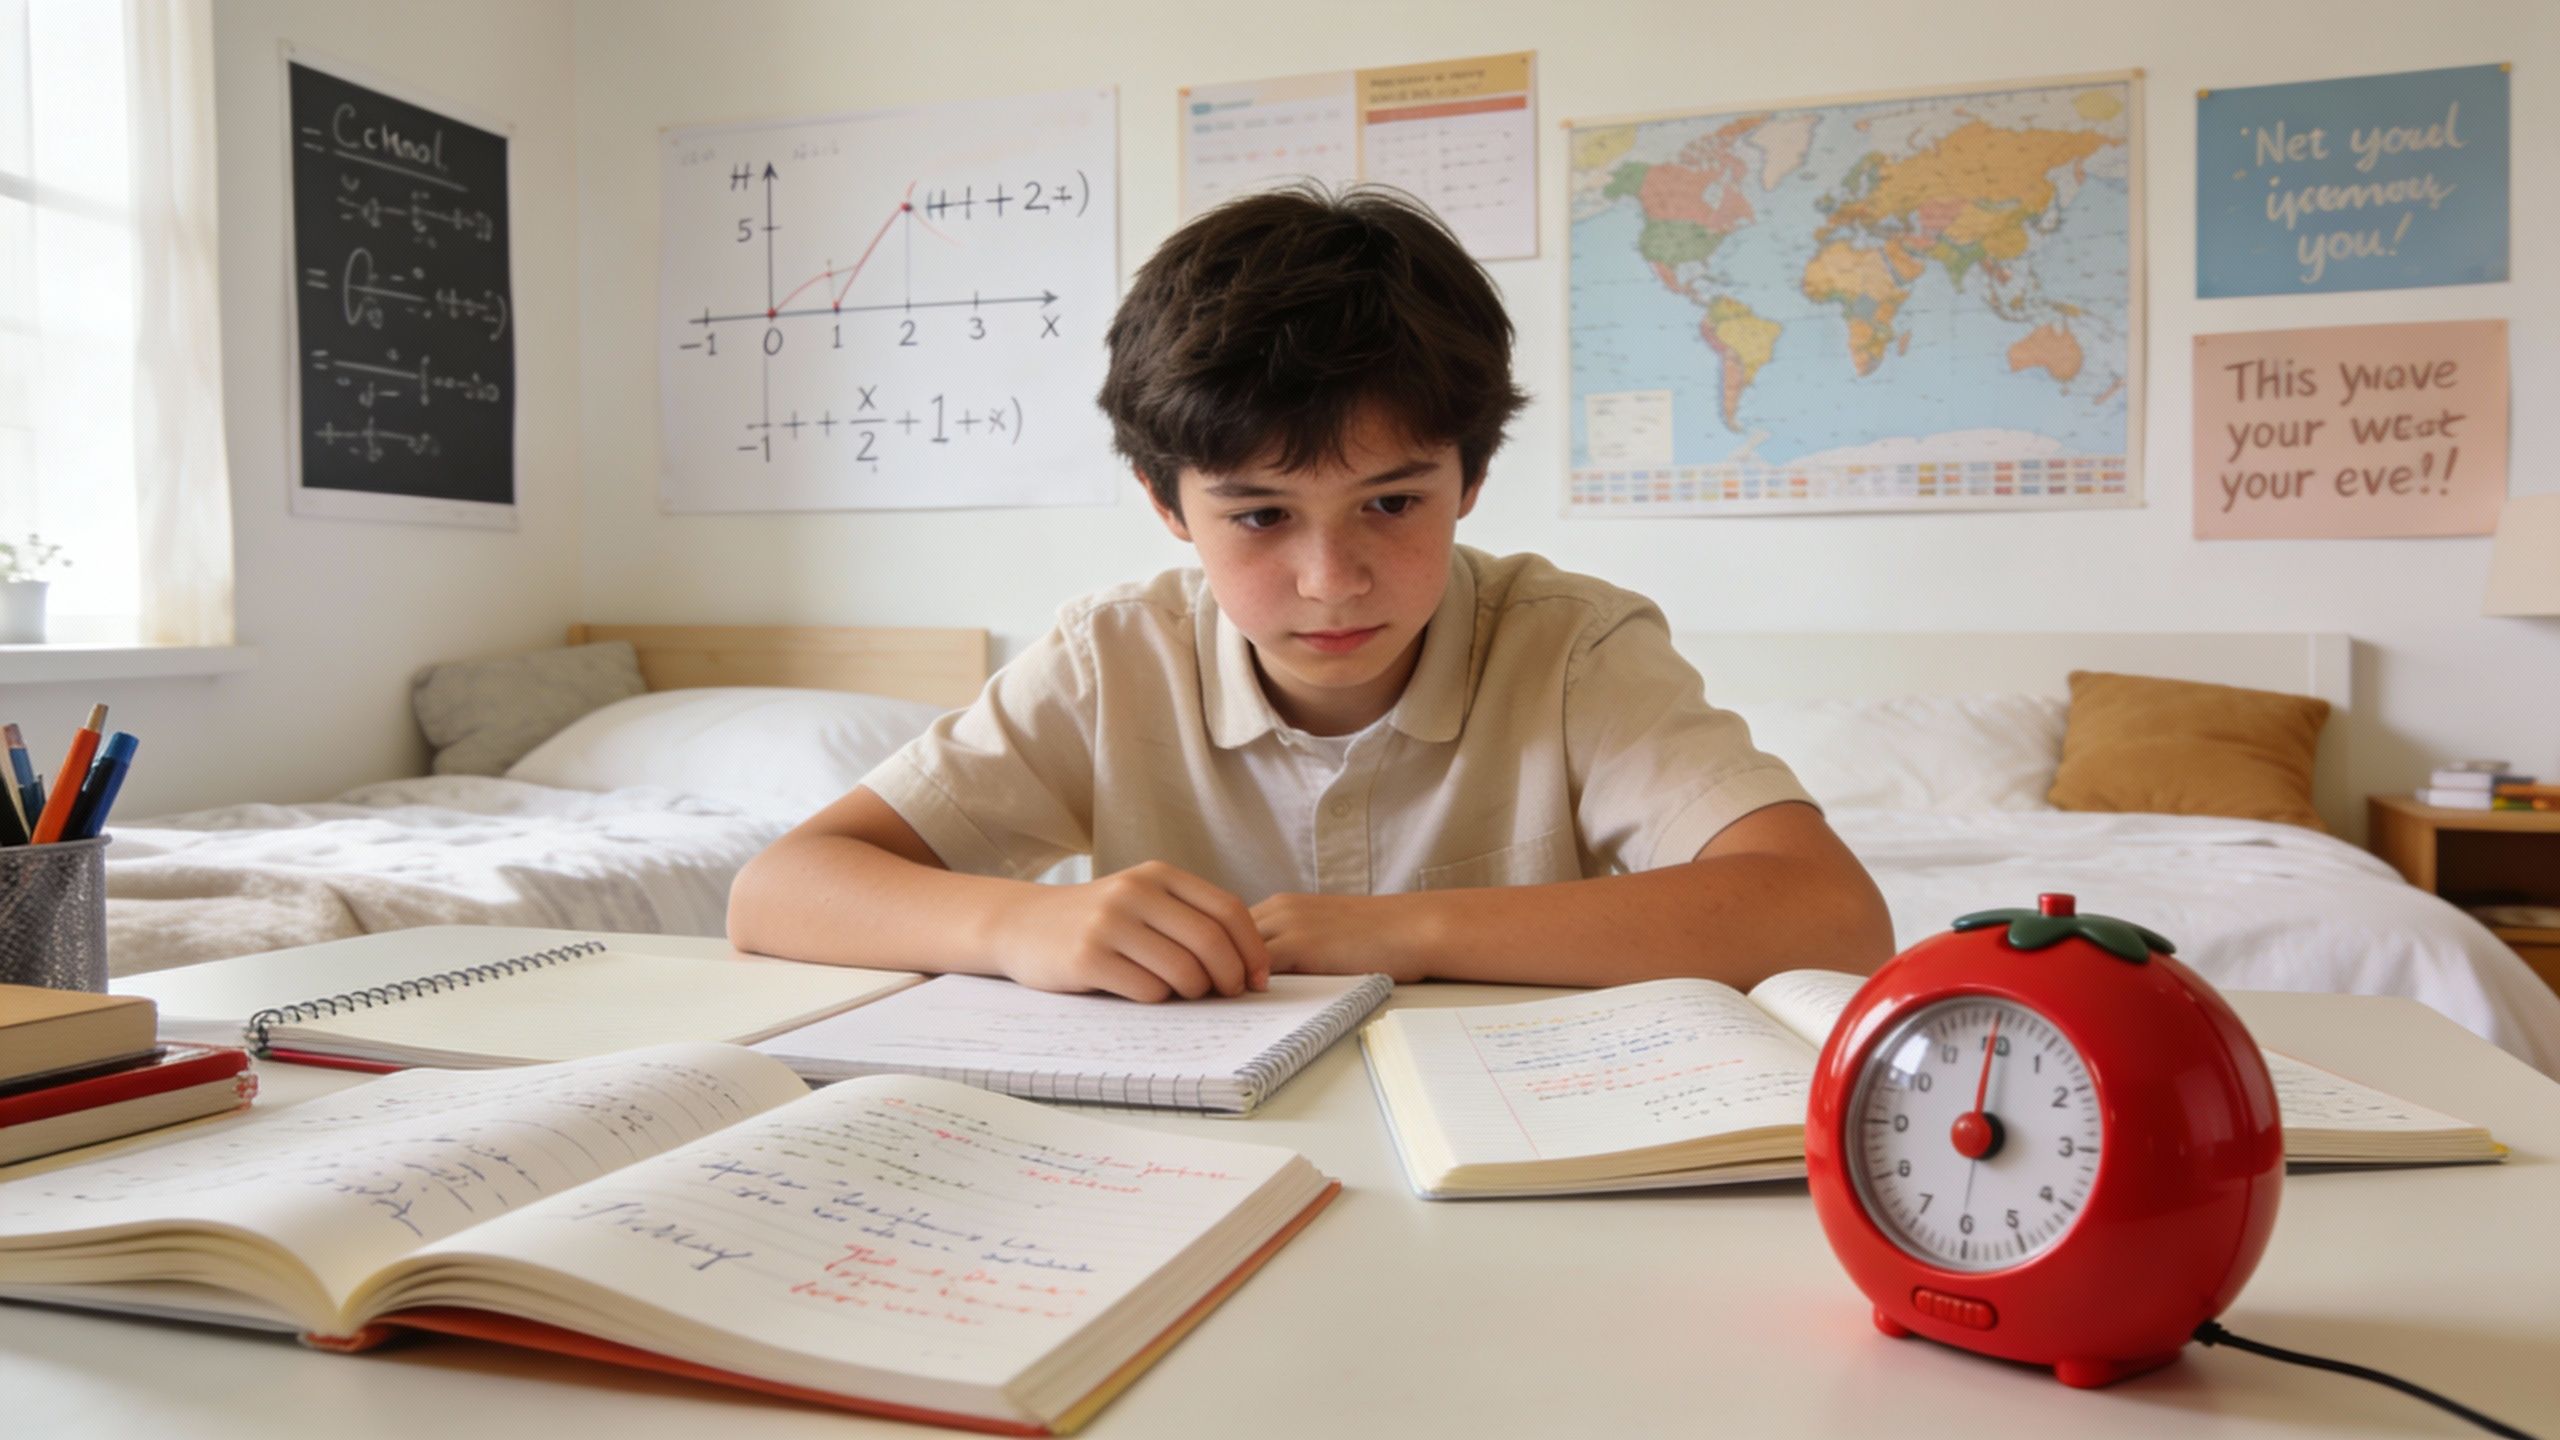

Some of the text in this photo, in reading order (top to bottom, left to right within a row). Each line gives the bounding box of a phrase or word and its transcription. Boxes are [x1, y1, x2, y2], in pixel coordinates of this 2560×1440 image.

[736, 218, 752, 242] 5
[763, 327, 783, 355] 0
[832, 324, 843, 348] 1
[899, 320, 918, 345] 2
[968, 317, 986, 340] 3
[2227, 420, 2326, 463] your
[2220, 470, 2315, 513] your
[2033, 1054, 2041, 1074] 1
[2052, 1086, 2069, 1108] 2
[2059, 1136, 2074, 1157] 3
[1920, 1193, 1934, 1214] 7
[1960, 1214, 1974, 1235] 6
[2006, 1209, 2019, 1229] 5
